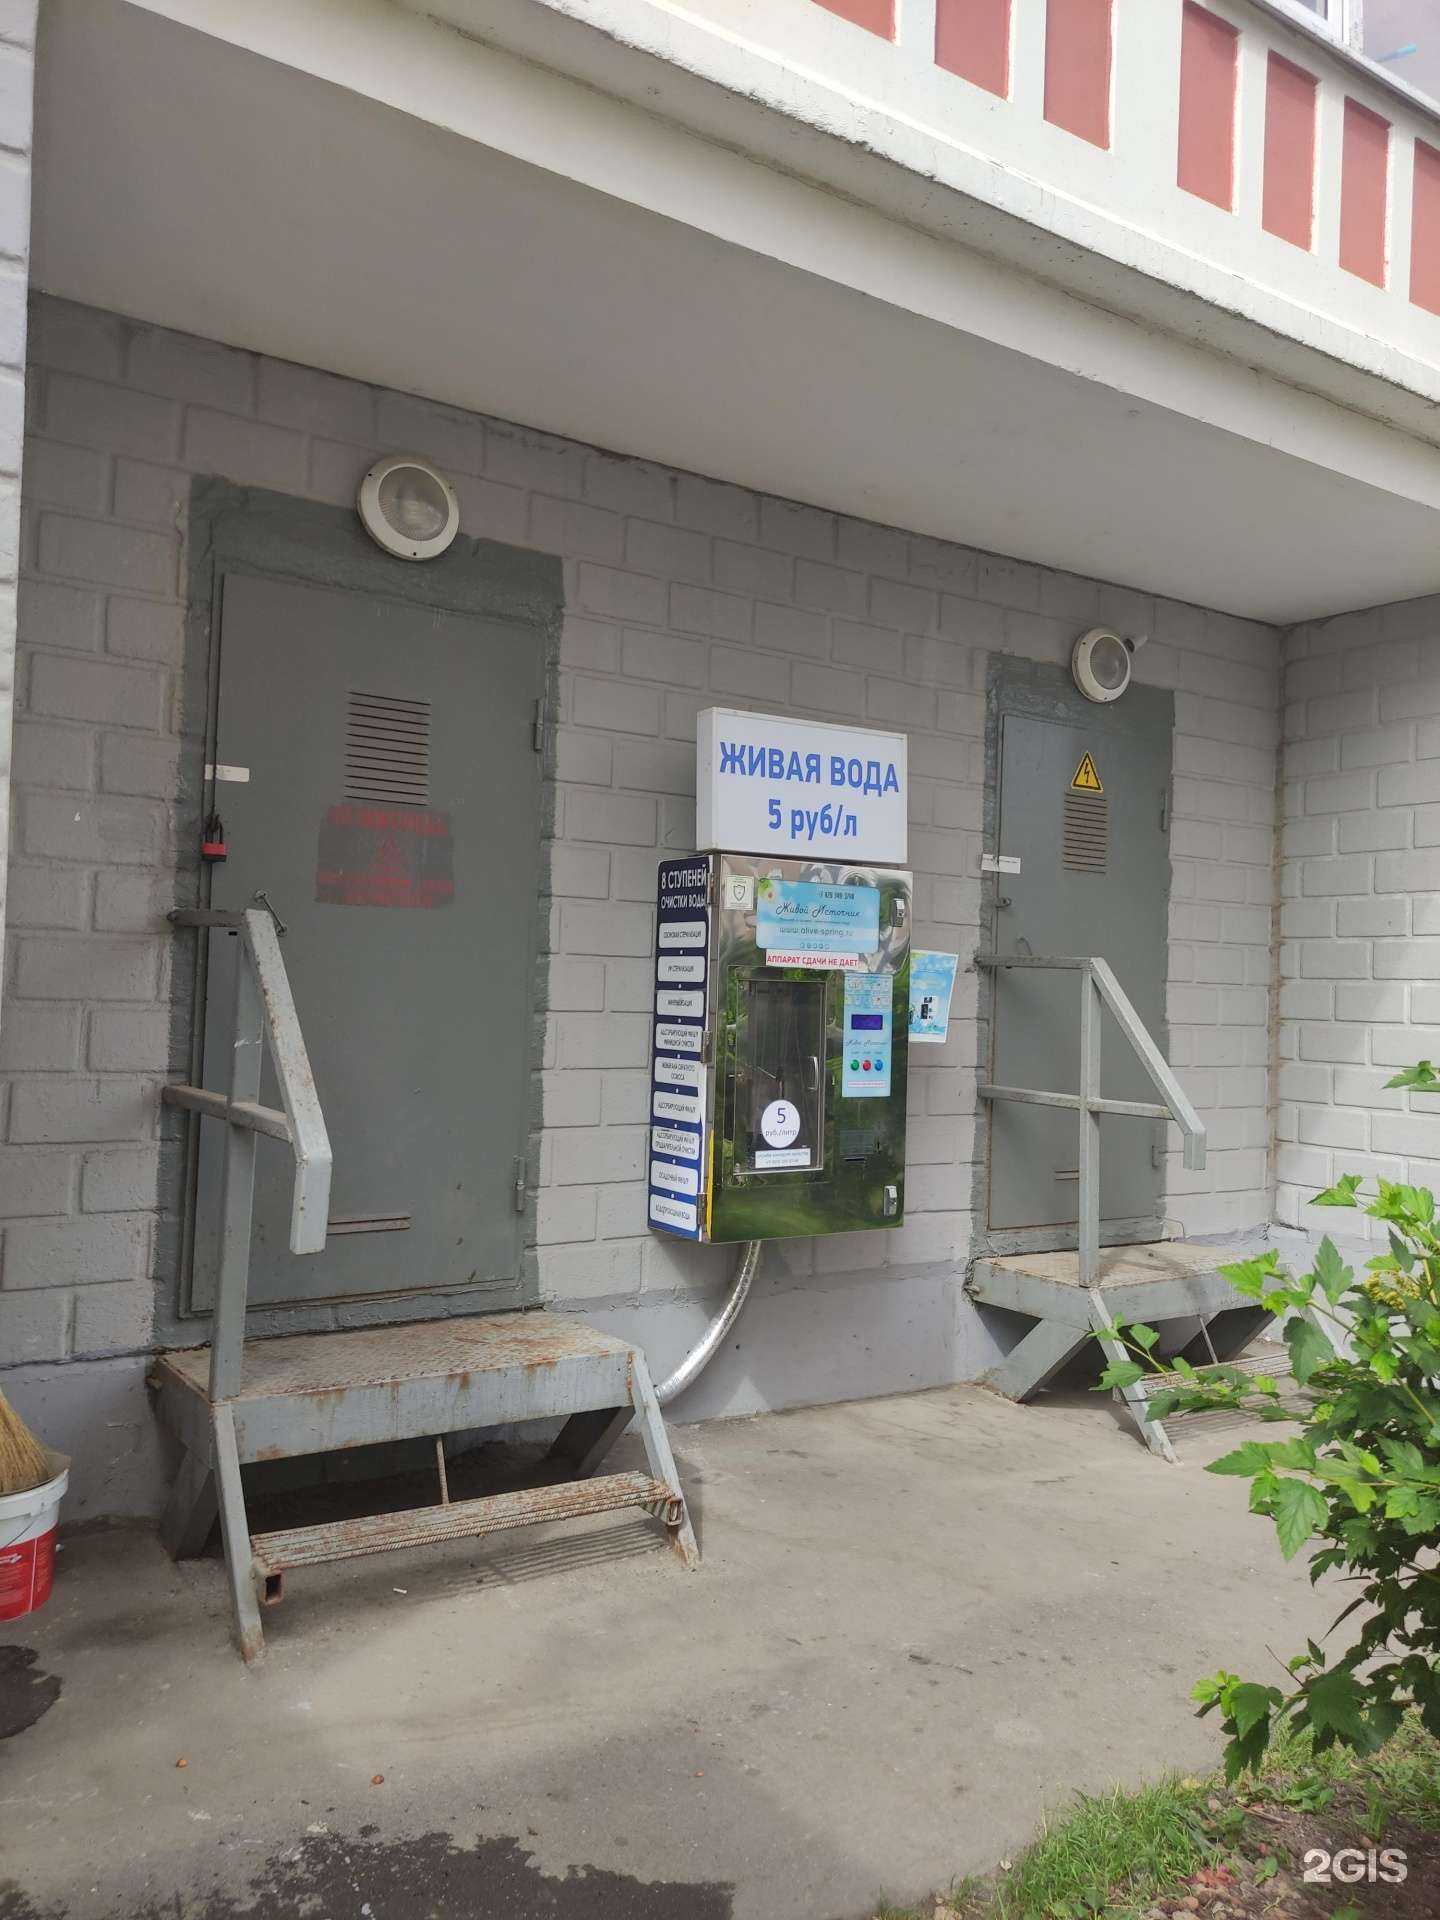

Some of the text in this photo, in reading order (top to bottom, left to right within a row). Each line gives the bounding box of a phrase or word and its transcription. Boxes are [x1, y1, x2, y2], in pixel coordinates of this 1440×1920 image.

[719, 741, 899, 797] ЖИВАЯ ВОДА
[768, 798, 857, 841] 5 руб/л
[661, 864, 707, 890] 8 СТУПЕНЕЙ
[661, 893, 706, 909] ОЧИСТКИ ВОДЫ
[775, 901, 809, 915] Живой
[767, 955, 858, 967] АППАРАТ СДАЧИ НЕ ДАЕТ
[777, 1107, 786, 1124] 5
